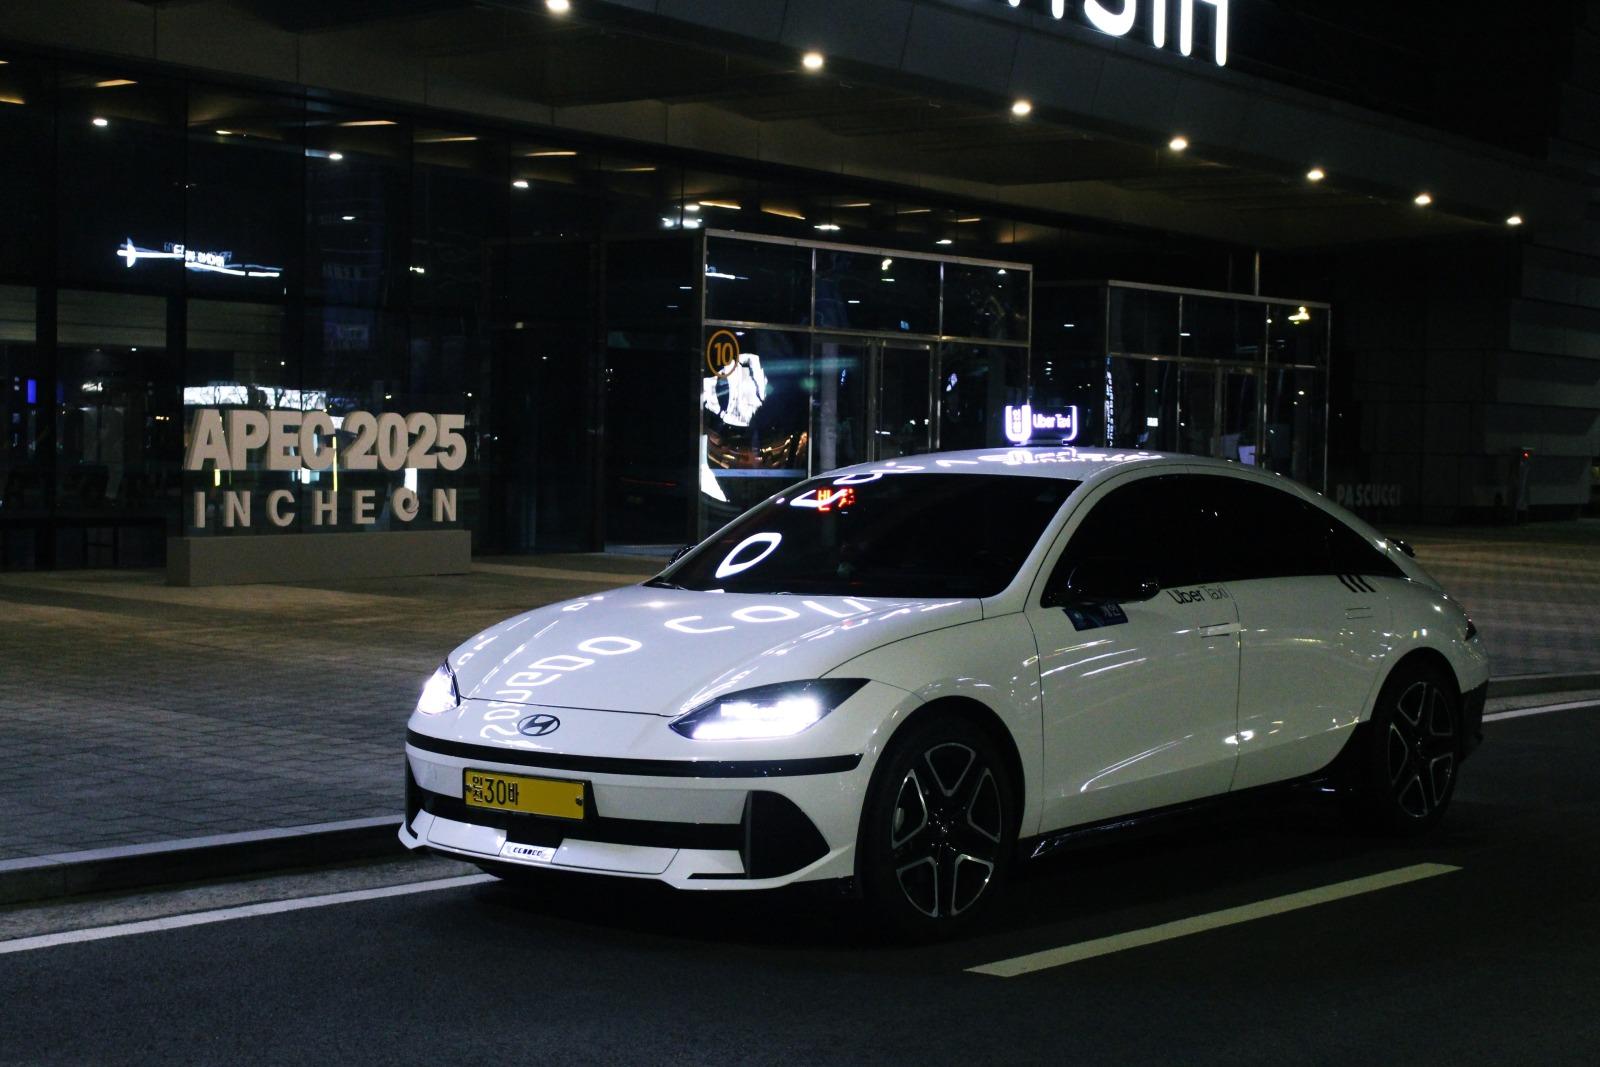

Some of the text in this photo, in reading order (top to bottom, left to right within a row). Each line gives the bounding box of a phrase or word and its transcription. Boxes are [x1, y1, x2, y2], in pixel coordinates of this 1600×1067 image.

[715, 342, 734, 367] 10
[1033, 414, 1055, 428] Uber
[1056, 413, 1071, 428] Taxi
[184, 408, 467, 471] APEC 2025
[193, 487, 457, 528] INCHEON
[1336, 484, 1401, 507] PASCUCCI
[1167, 584, 1230, 604] Uber Taxi
